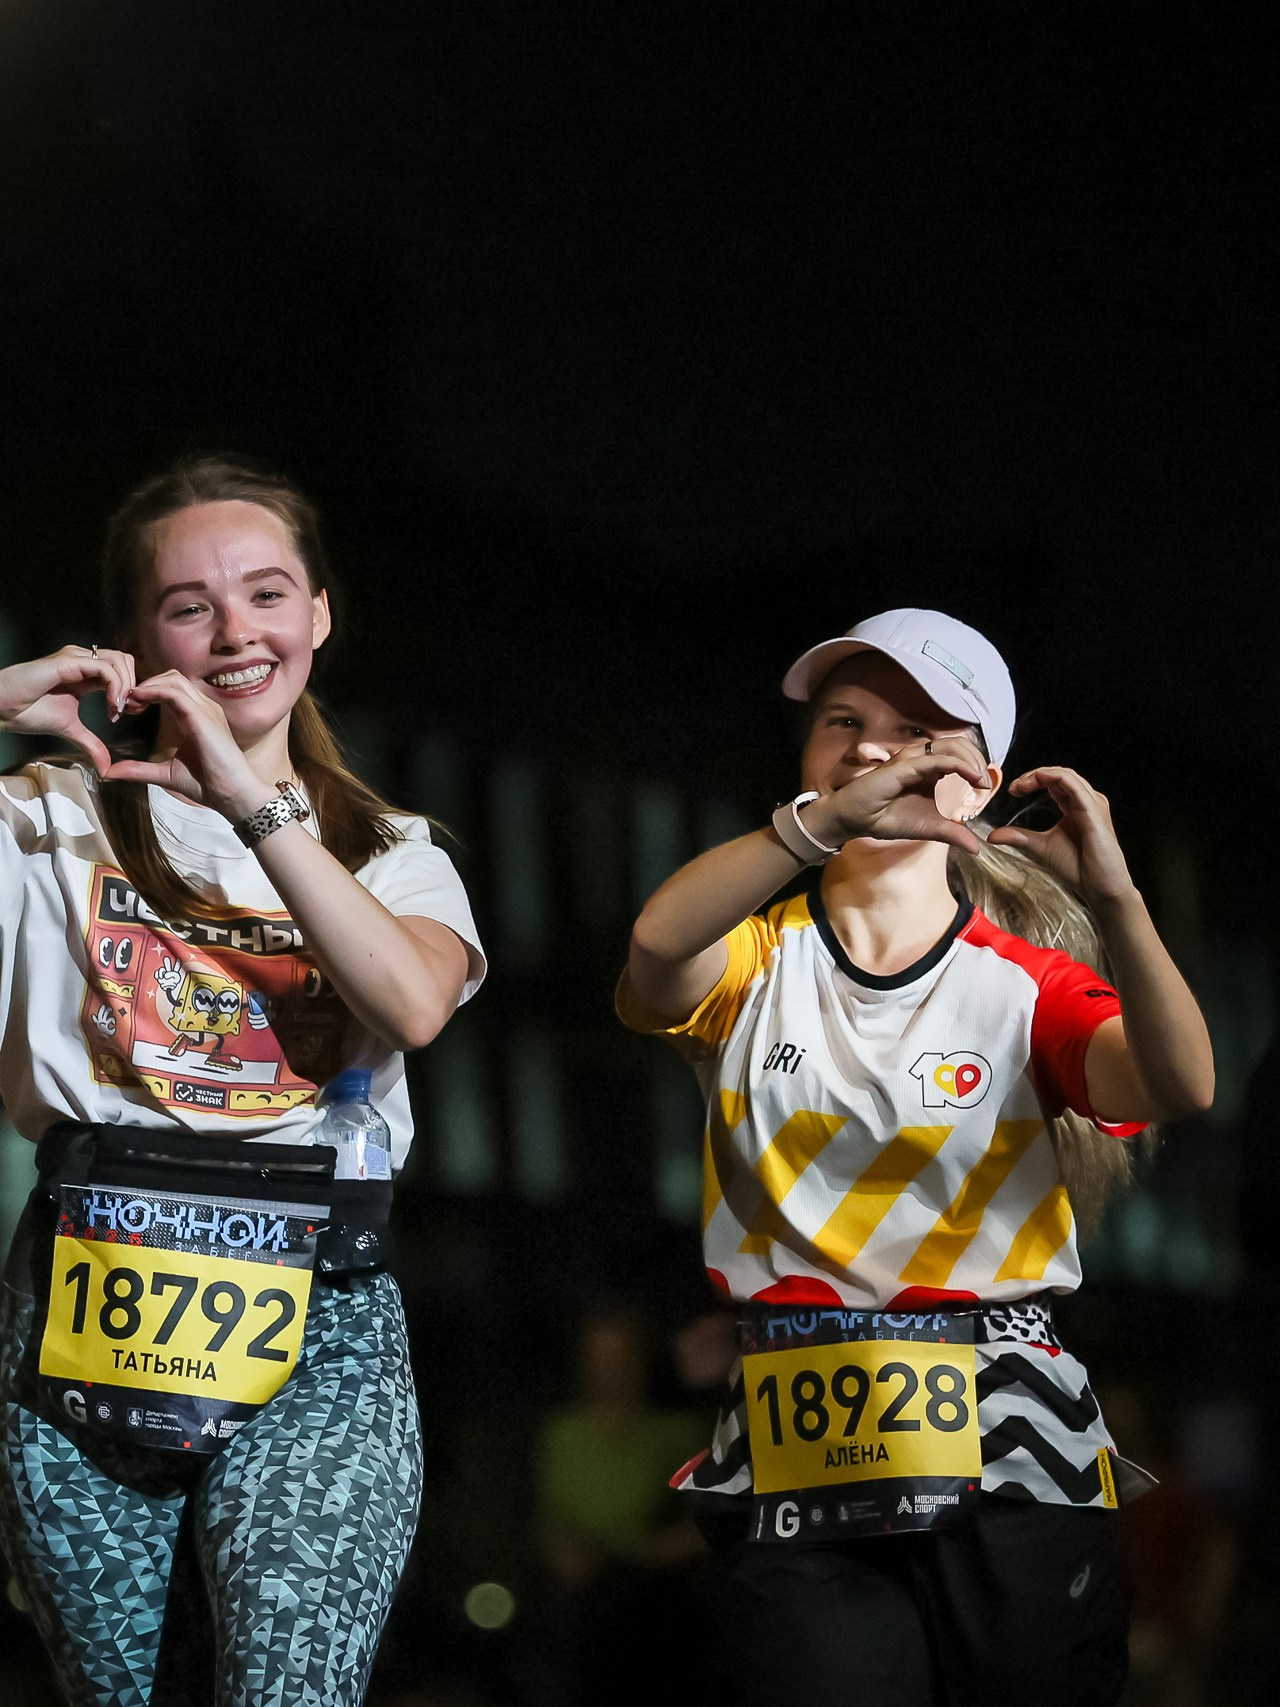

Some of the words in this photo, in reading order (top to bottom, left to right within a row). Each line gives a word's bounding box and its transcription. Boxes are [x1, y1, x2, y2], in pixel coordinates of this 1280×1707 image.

[195, 1089, 224, 1098] ЧЕСТНЫЙ
[195, 1094, 223, 1106] ЗНАК
[83, 1189, 289, 1253] НОЧНОЙ
[174, 1241, 252, 1262] ЗАБЕГ
[64, 1262, 297, 1363] 18792
[842, 1330, 916, 1342] ЗАБЕГ
[111, 1349, 218, 1382] ТАТЬЯНА
[63, 1389, 88, 1424] G
[757, 1361, 970, 1446] 18928
[825, 1440, 890, 1470] АЛЁНА
[914, 1493, 960, 1505] МОСКОВСКИЙ
[914, 1504, 937, 1514] СПОРТ
[775, 1501, 800, 1539] G
